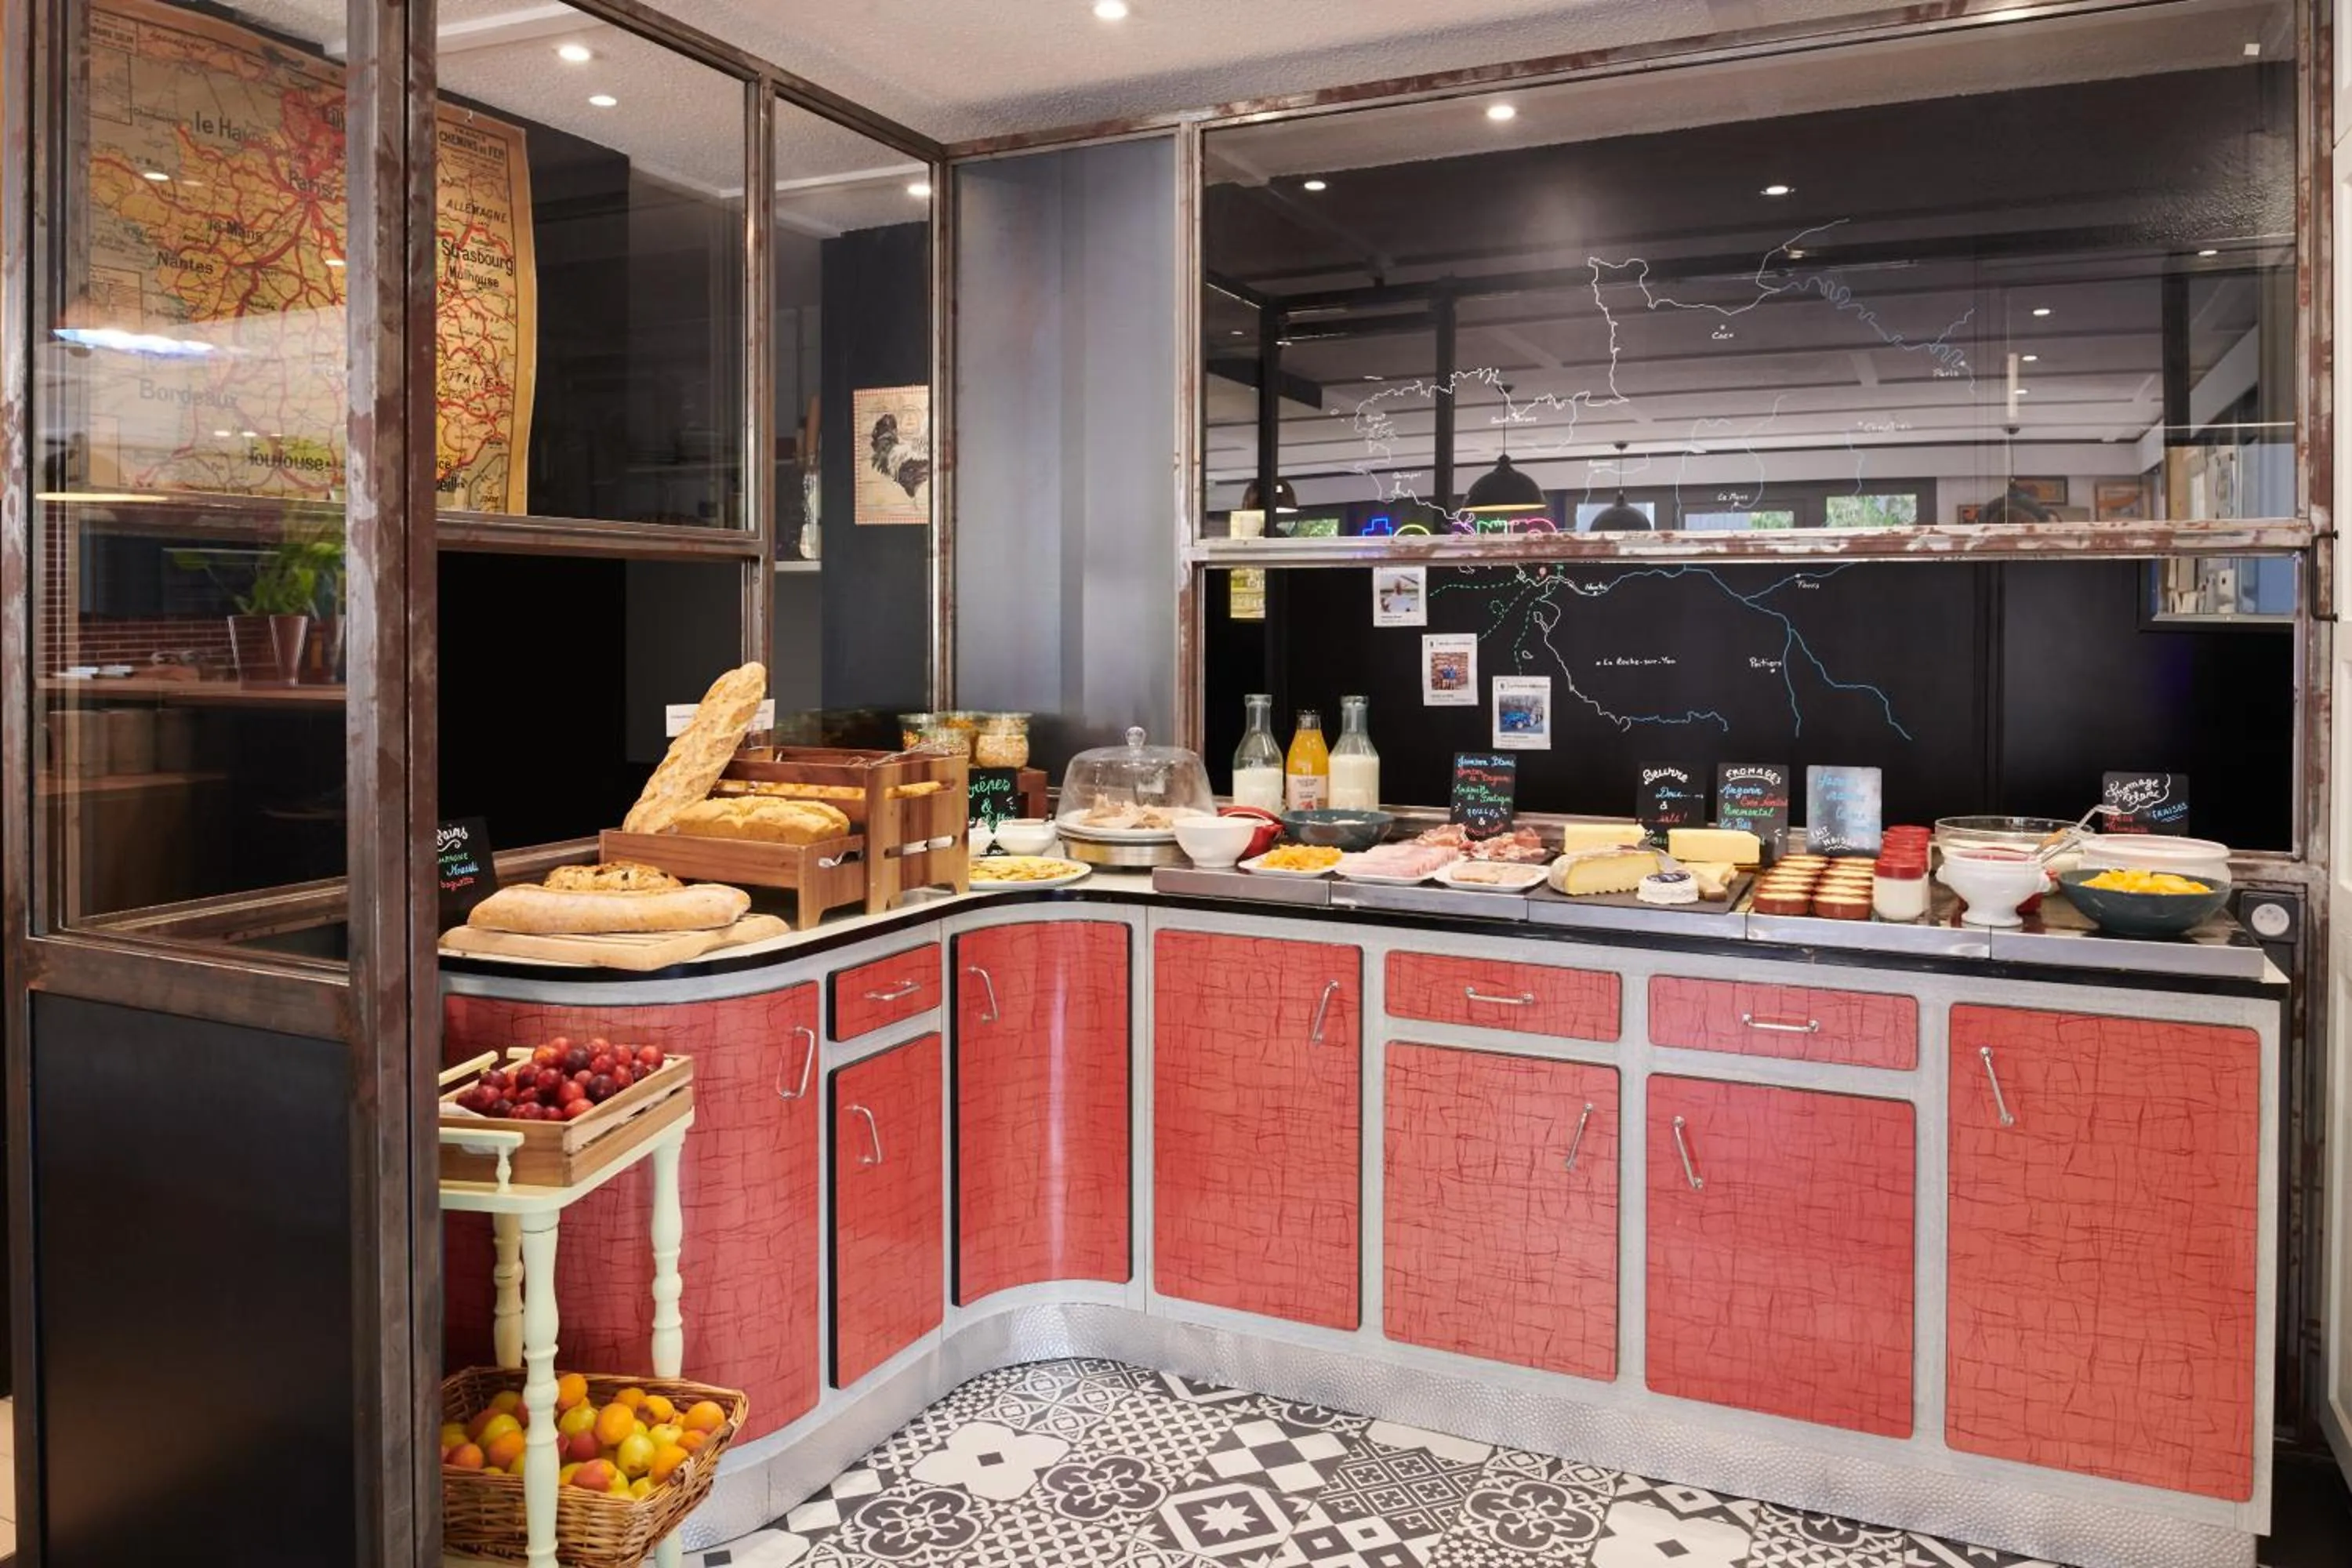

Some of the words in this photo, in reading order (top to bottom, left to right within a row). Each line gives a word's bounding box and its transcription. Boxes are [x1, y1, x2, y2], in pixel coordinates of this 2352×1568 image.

[196, 111, 214, 134] le
[446, 199, 508, 223] ALLEMAGNE
[157, 250, 214, 275] Nantes
[441, 238, 514, 276] Strasbourg
[449, 265, 499, 288] Mulhouse
[139, 379, 238, 409] Bordeaux
[249, 446, 326, 472] Toulouse
[968, 775, 1011, 798] rêpes
[1642, 767, 1689, 785] Beurre
[1726, 768, 1782, 785] FROMAGES
[2106, 779, 2159, 804] Fromage
[2123, 789, 2161, 807] Blanc
[980, 798, 994, 815] &
